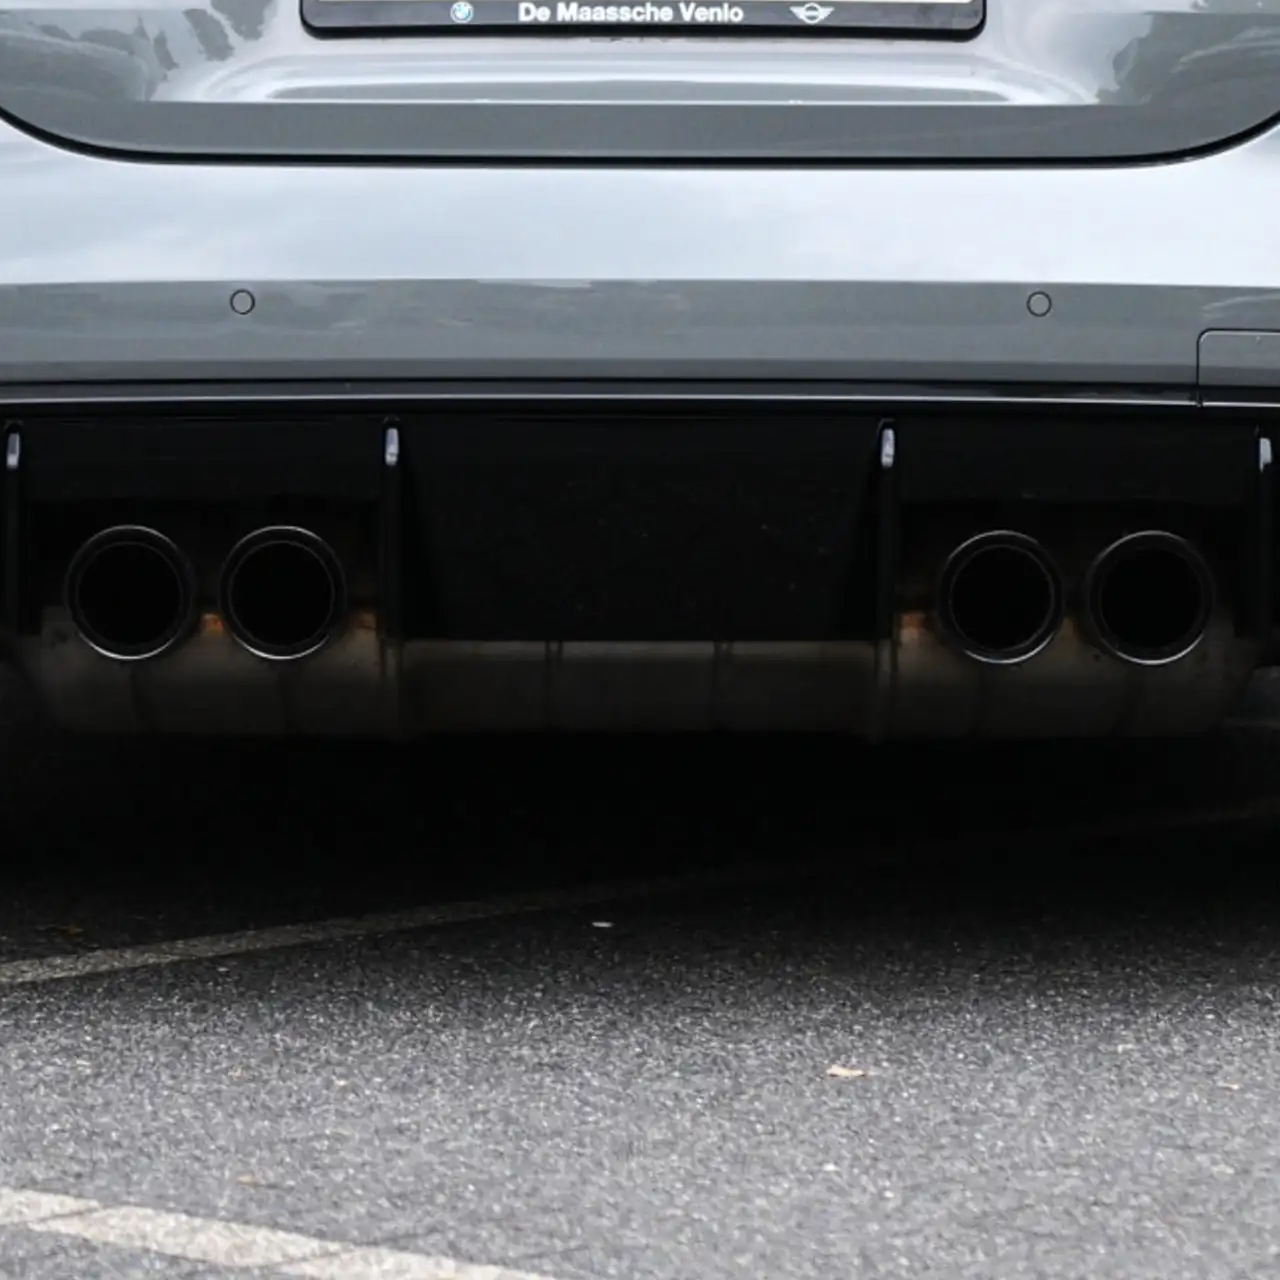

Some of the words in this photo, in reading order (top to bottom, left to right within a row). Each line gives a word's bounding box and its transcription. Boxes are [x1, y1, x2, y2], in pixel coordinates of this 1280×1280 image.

[519, 2, 550, 21] De
[557, 2, 673, 22] Maassche
[678, 3, 743, 23] Venlo
